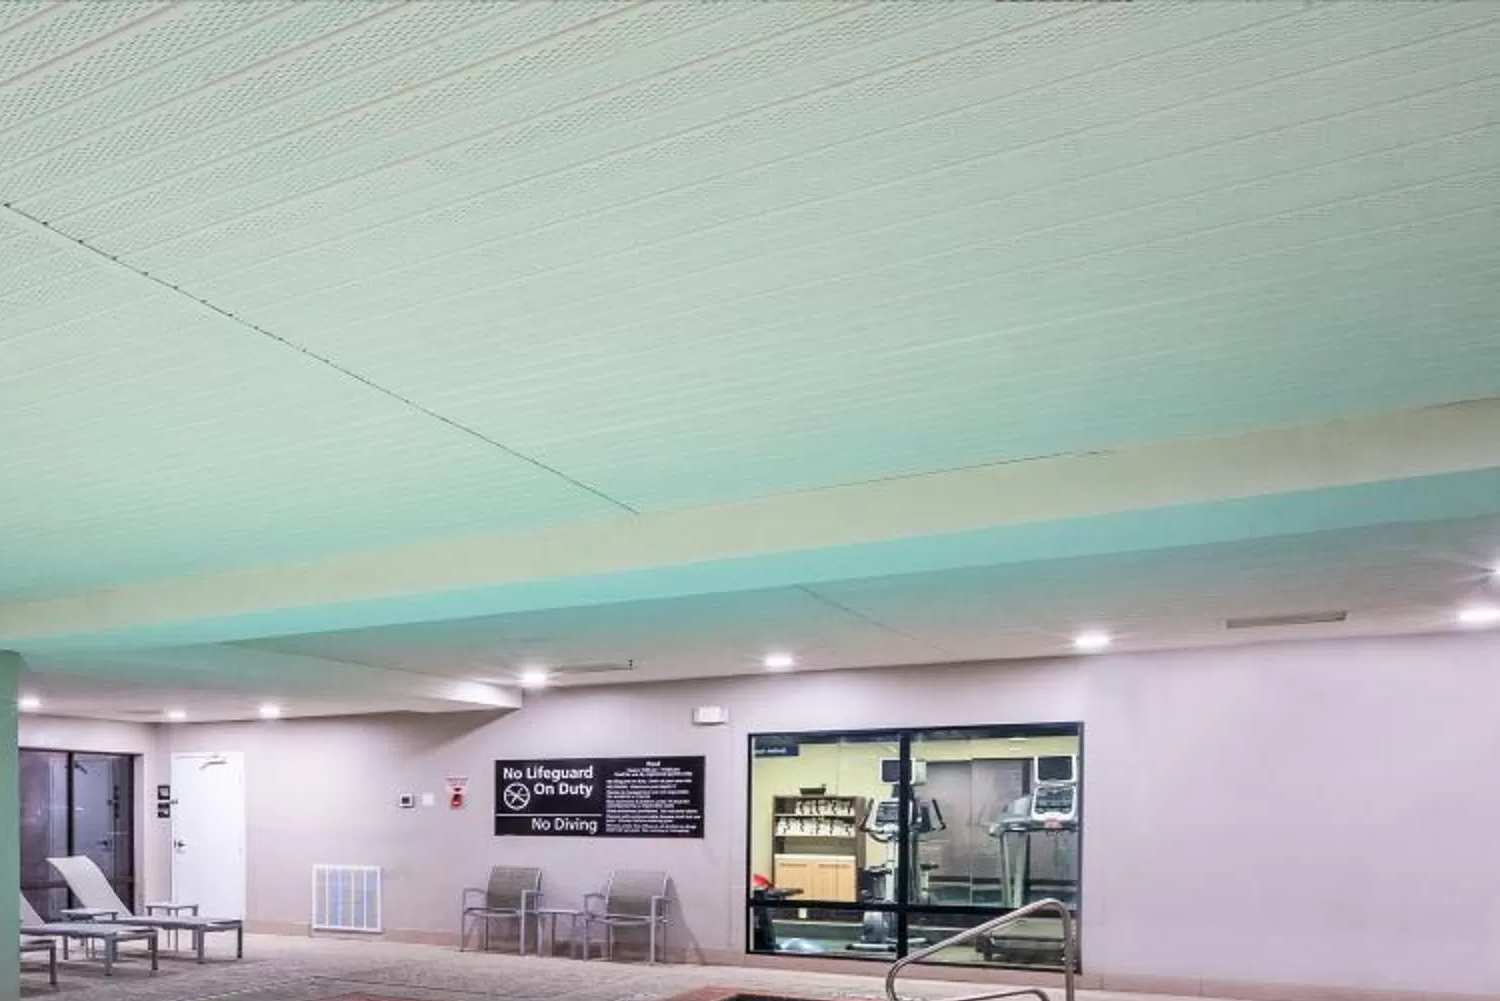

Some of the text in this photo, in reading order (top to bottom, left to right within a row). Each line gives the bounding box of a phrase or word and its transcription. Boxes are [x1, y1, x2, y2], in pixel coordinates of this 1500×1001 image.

[503, 764, 594, 783] No Lifeguard
[534, 782, 594, 798] On Duty
[531, 817, 598, 835] No Diving
